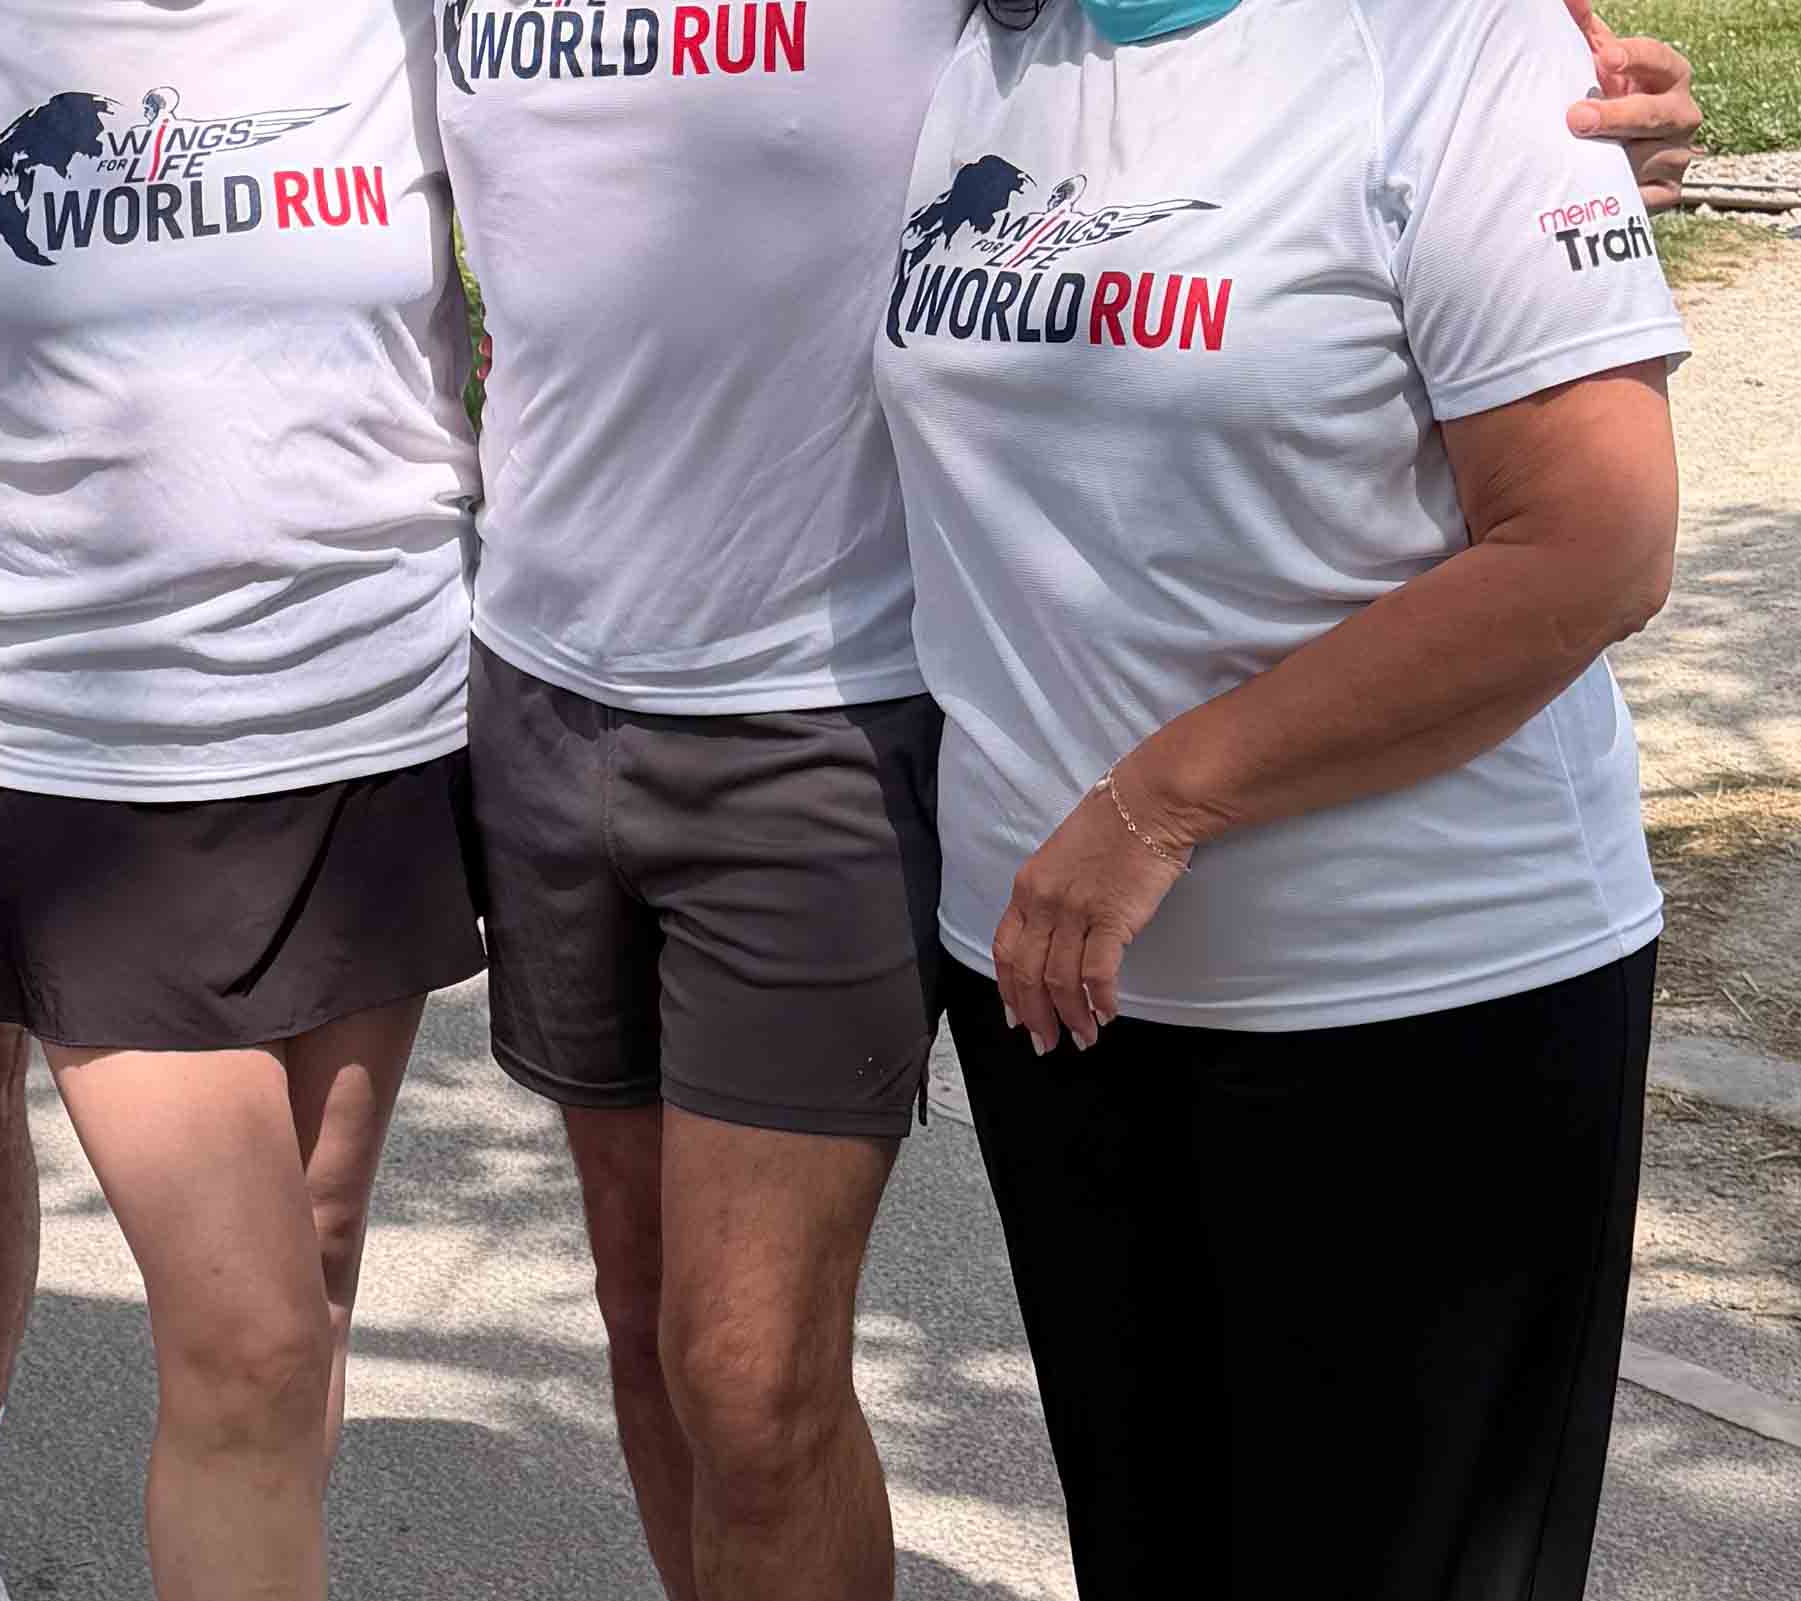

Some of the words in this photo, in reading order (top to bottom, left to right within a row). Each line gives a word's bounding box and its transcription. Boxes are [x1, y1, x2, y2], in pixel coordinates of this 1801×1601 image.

[470, 6, 660, 79] WORLD
[672, 1, 808, 76] RUN
[108, 119, 254, 157] WINGS
[99, 158, 128, 172] FOR
[124, 151, 211, 184] LIFE
[44, 175, 262, 251] WORLD
[274, 166, 389, 229] RUN
[1538, 196, 1621, 232] meine
[997, 209, 1120, 245] WINGS
[971, 239, 1002, 254] FOR
[984, 244, 1072, 270] LIFE
[905, 263, 1086, 344] WORLD
[1088, 271, 1233, 351] RUN
